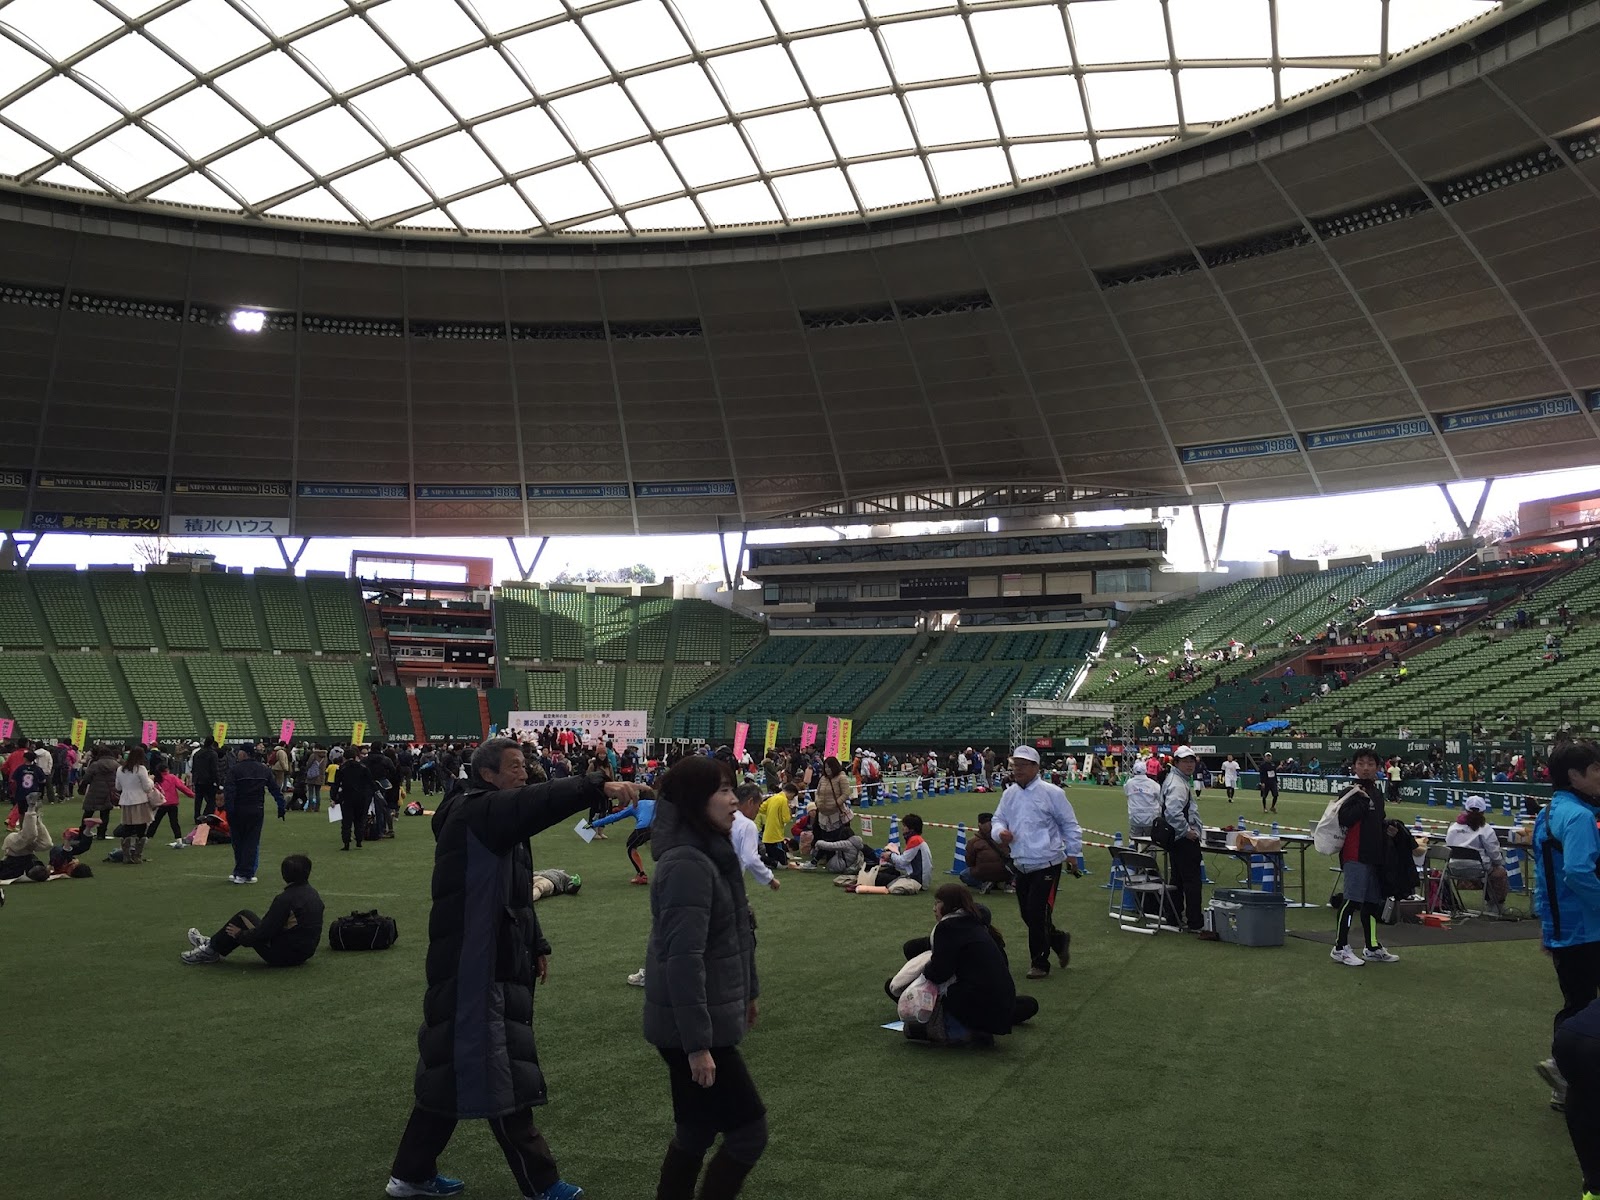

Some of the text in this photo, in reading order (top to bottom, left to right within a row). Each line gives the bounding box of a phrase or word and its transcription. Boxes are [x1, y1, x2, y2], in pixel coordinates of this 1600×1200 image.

[1460, 397, 1574, 425] NIPPON CHAMPIONS 1991
[1323, 420, 1429, 443] NIPPON CHAMPIONS 1990
[1198, 438, 1295, 457] NIPPON CHAMPIONS 1988
[55, 478, 160, 491] NIPPON CHAMPIONS 1957
[189, 482, 287, 495] NIPPON CHAMPIONS 1958
[62, 515, 160, 530] 夢は宇宙で家づくり
[184, 518, 275, 533] 積水ハウス
[1348, 742, 1376, 750] ベルスタッフ
[1445, 740, 1460, 754] 3M
[22, 773, 34, 789] 8
